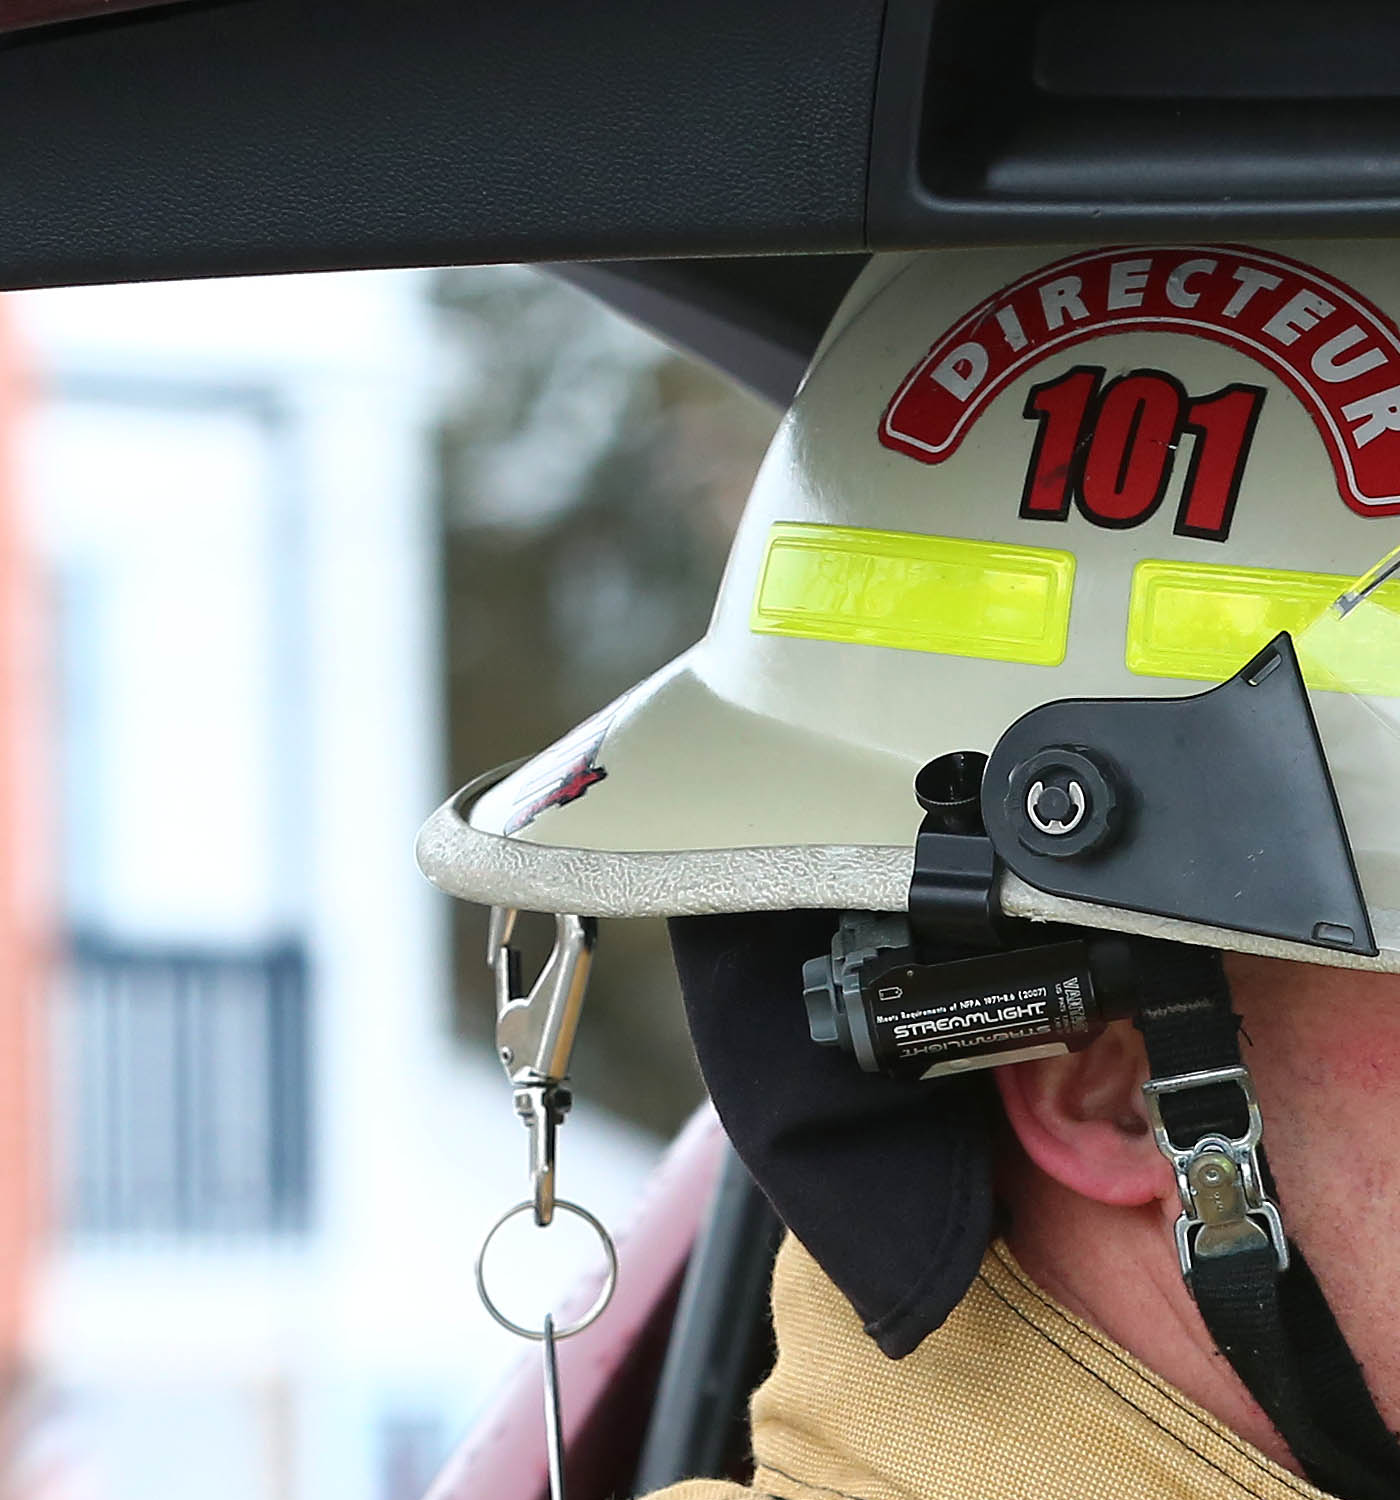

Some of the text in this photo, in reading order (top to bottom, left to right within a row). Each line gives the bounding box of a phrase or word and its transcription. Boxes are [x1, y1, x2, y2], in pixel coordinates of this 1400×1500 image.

[1019, 364, 1267, 543] 101
[959, 998, 981, 1010] NFPA
[1018, 986, 1047, 1001] (2007)
[894, 1001, 1047, 1040] STREAMLIGHT
